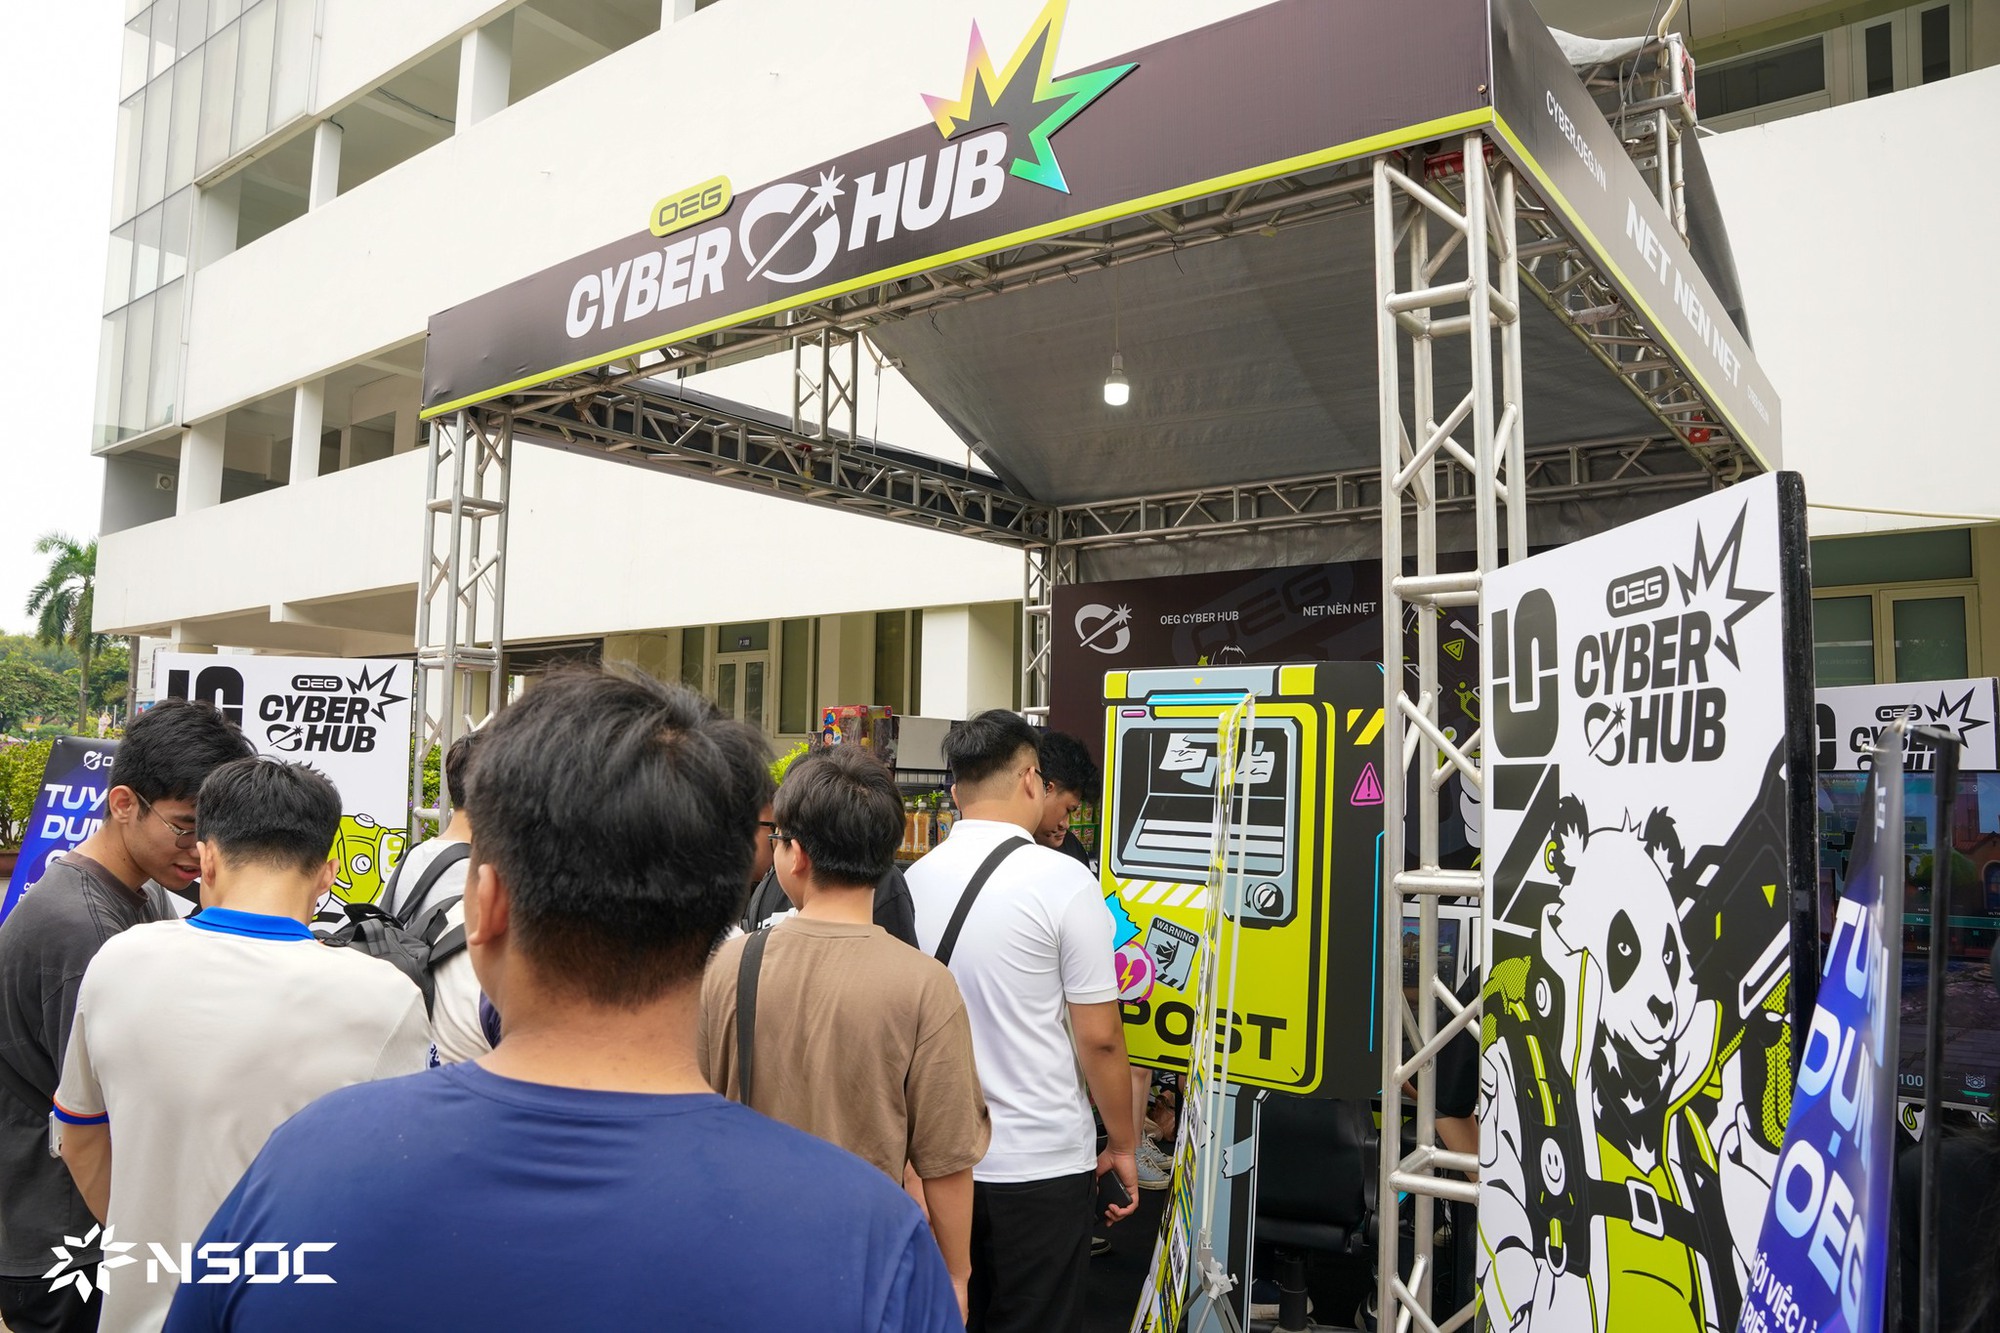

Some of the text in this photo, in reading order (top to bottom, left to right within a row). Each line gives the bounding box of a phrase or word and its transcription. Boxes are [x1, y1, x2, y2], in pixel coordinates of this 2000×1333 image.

[1546, 90, 1607, 192] CYBER.OEG.VN
[658, 183, 723, 227] OEG
[565, 130, 1008, 340] CYBER HUB
[1626, 197, 1671, 286] NET
[1303, 605, 1325, 616] NET
[1612, 574, 1664, 610] OEG
[1160, 610, 1239, 625] OEG CYBER HUB
[1574, 610, 1712, 699] CYBER
[296, 679, 337, 689] OEG
[259, 695, 369, 724] CYBER
[1629, 686, 1727, 766] HUB
[304, 725, 376, 752] HUB
[1155, 919, 1196, 945] WARNING
[1120, 1000, 1287, 1061] POST
[1899, 1073, 1924, 1087] 100
[1775, 1139, 1867, 1333] OEG
